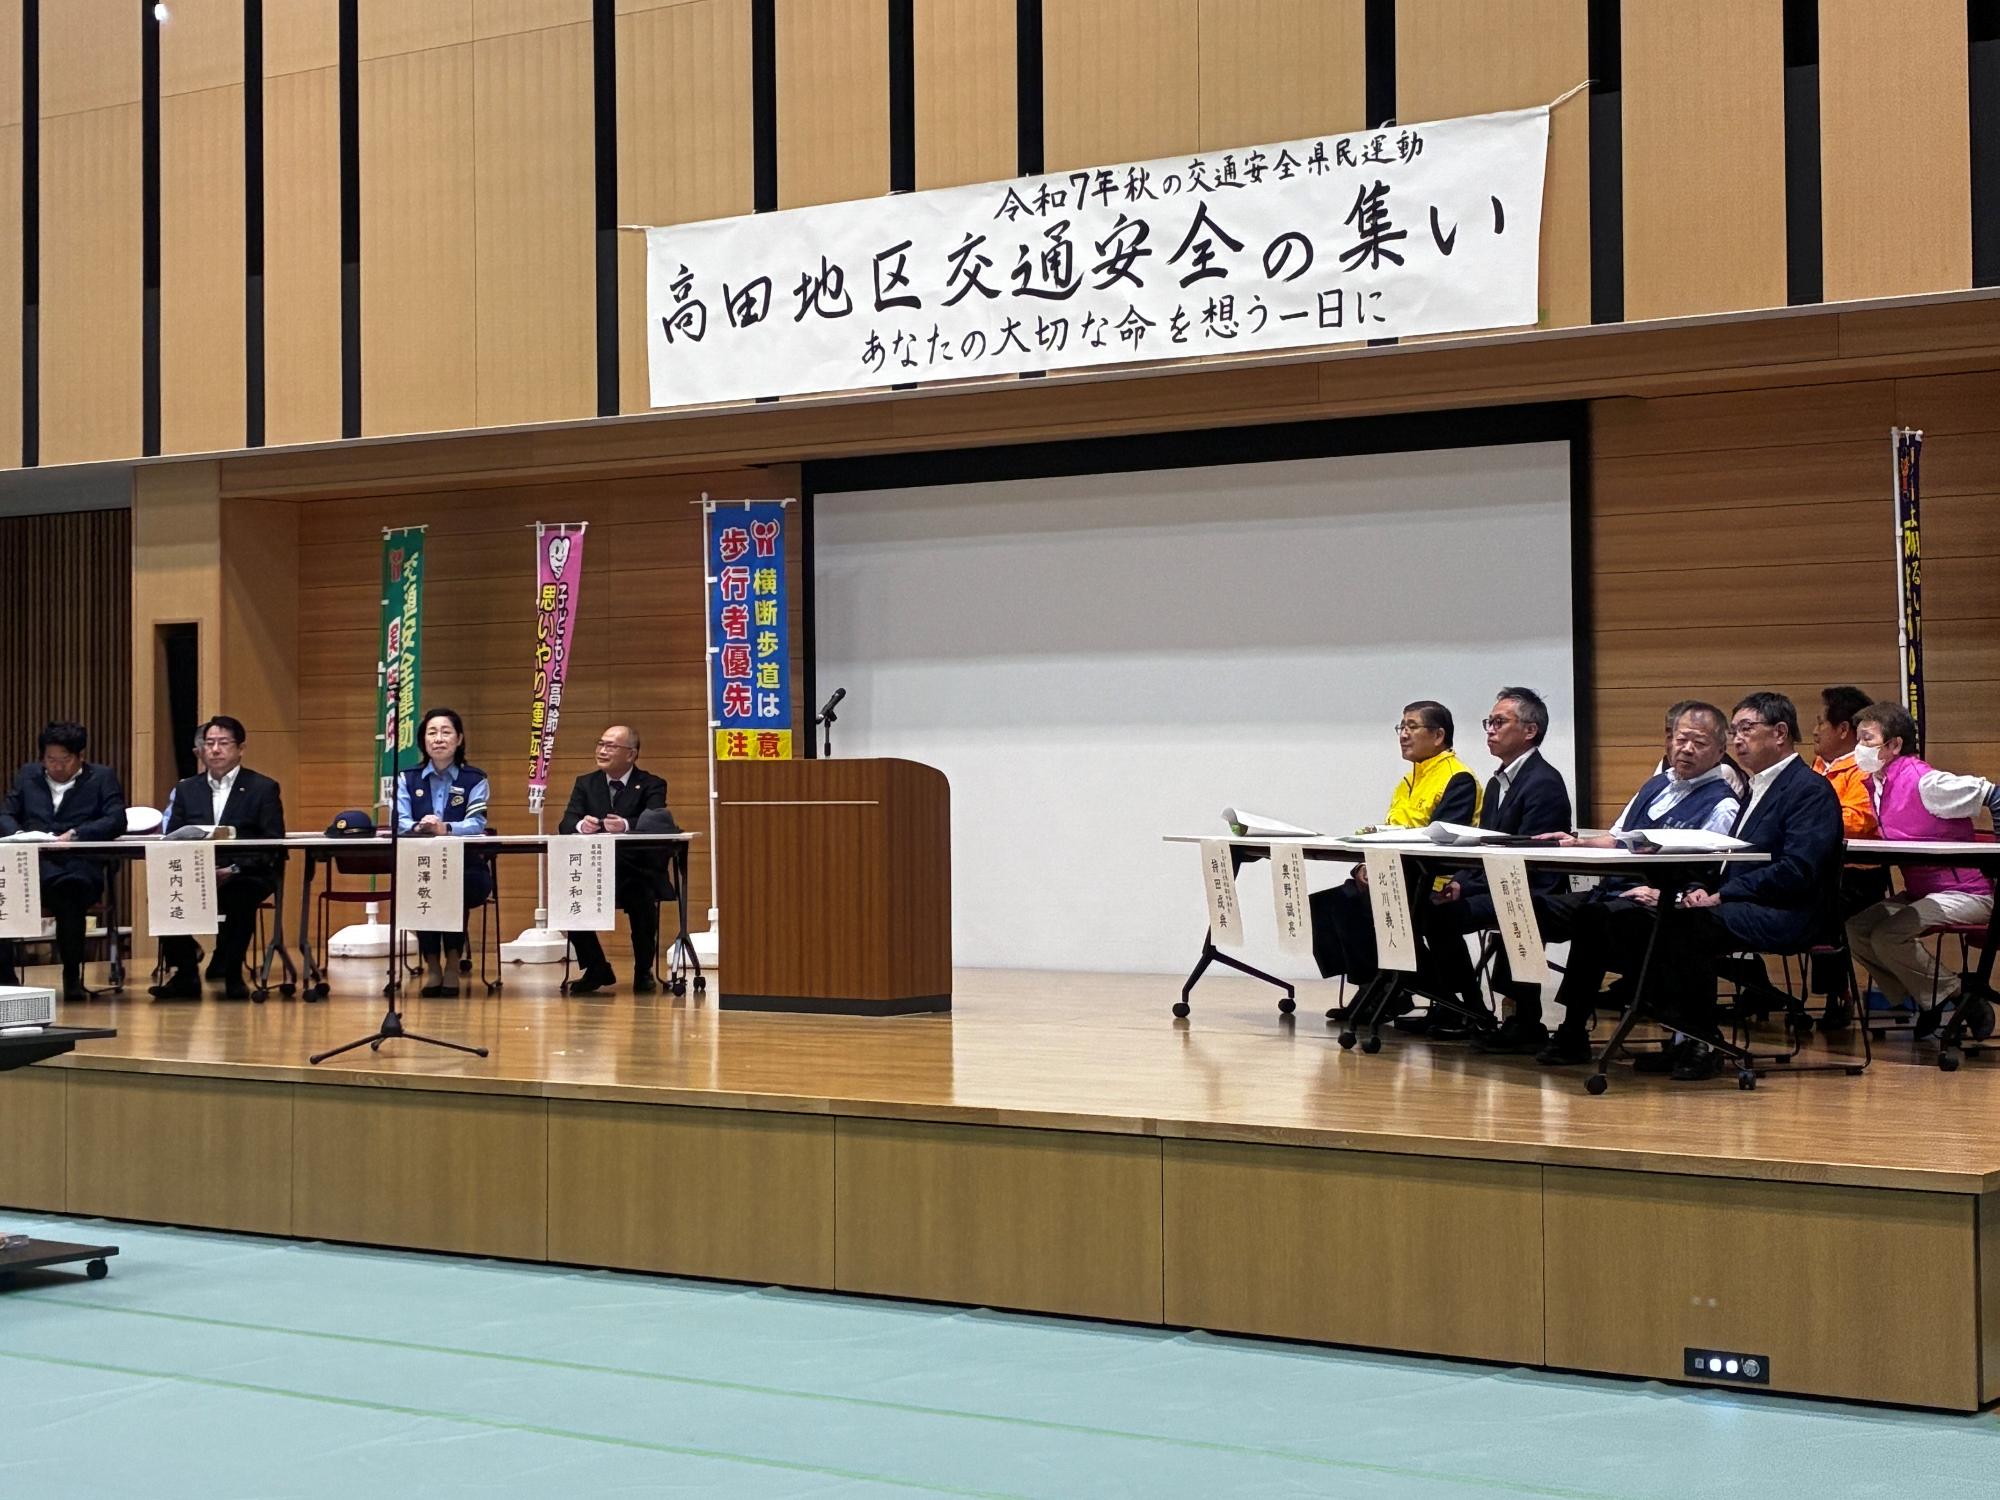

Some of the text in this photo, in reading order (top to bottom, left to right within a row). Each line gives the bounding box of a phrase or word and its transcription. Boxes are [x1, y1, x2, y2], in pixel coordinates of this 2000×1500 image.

[993, 130, 1425, 223] 令和7年秋の交通安全県民運動
[661, 180, 1506, 345] 高田地区交通安全の集い
[861, 290, 1386, 374] あなたの大切な命を想う一日に
[527, 583, 557, 780] 思いやり運転を
[720, 527, 751, 718] 歩行者優先
[753, 568, 780, 718] 横断歩道は
[727, 731, 780, 758] 注意
